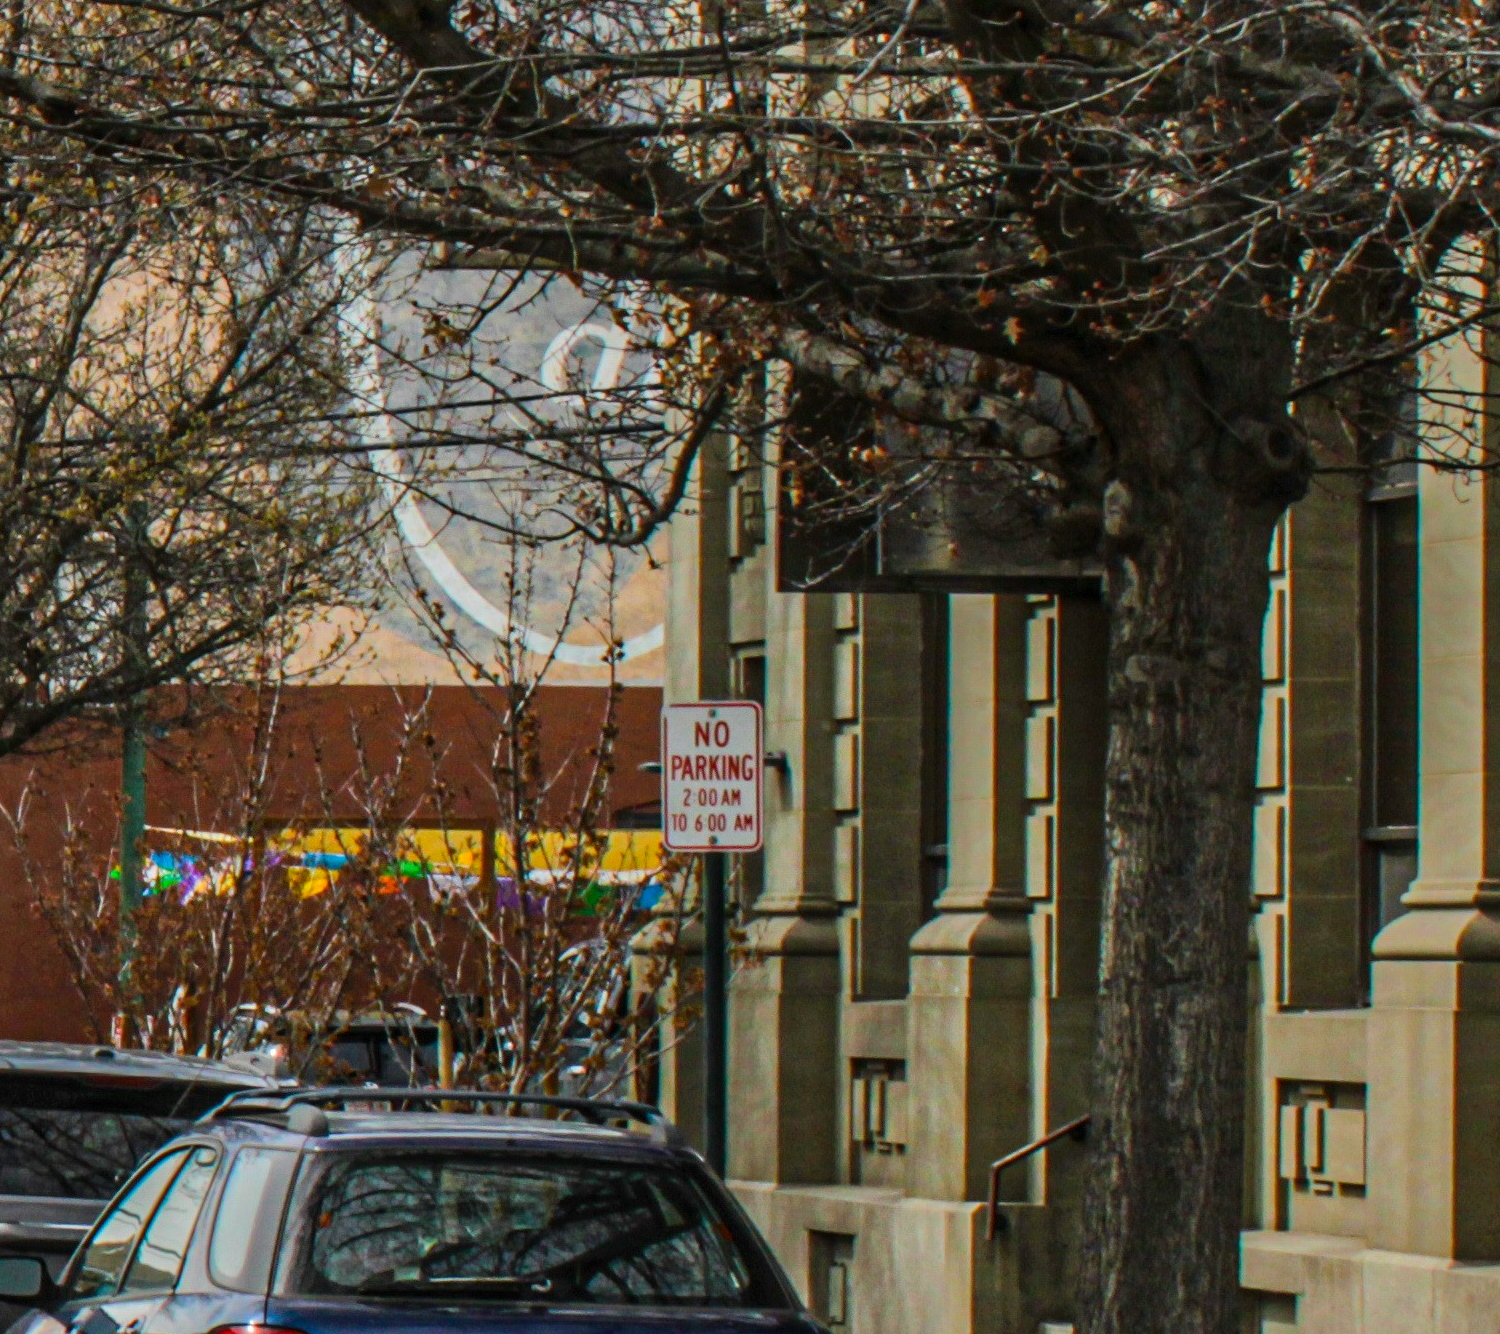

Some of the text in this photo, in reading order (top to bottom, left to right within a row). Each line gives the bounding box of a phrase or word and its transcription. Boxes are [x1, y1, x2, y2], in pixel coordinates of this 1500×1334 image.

[694, 721, 729, 747] NO
[671, 754, 753, 781] PARKING
[683, 788, 741, 807] 2:00 AM
[672, 814, 753, 832] TO 6:00 AM
